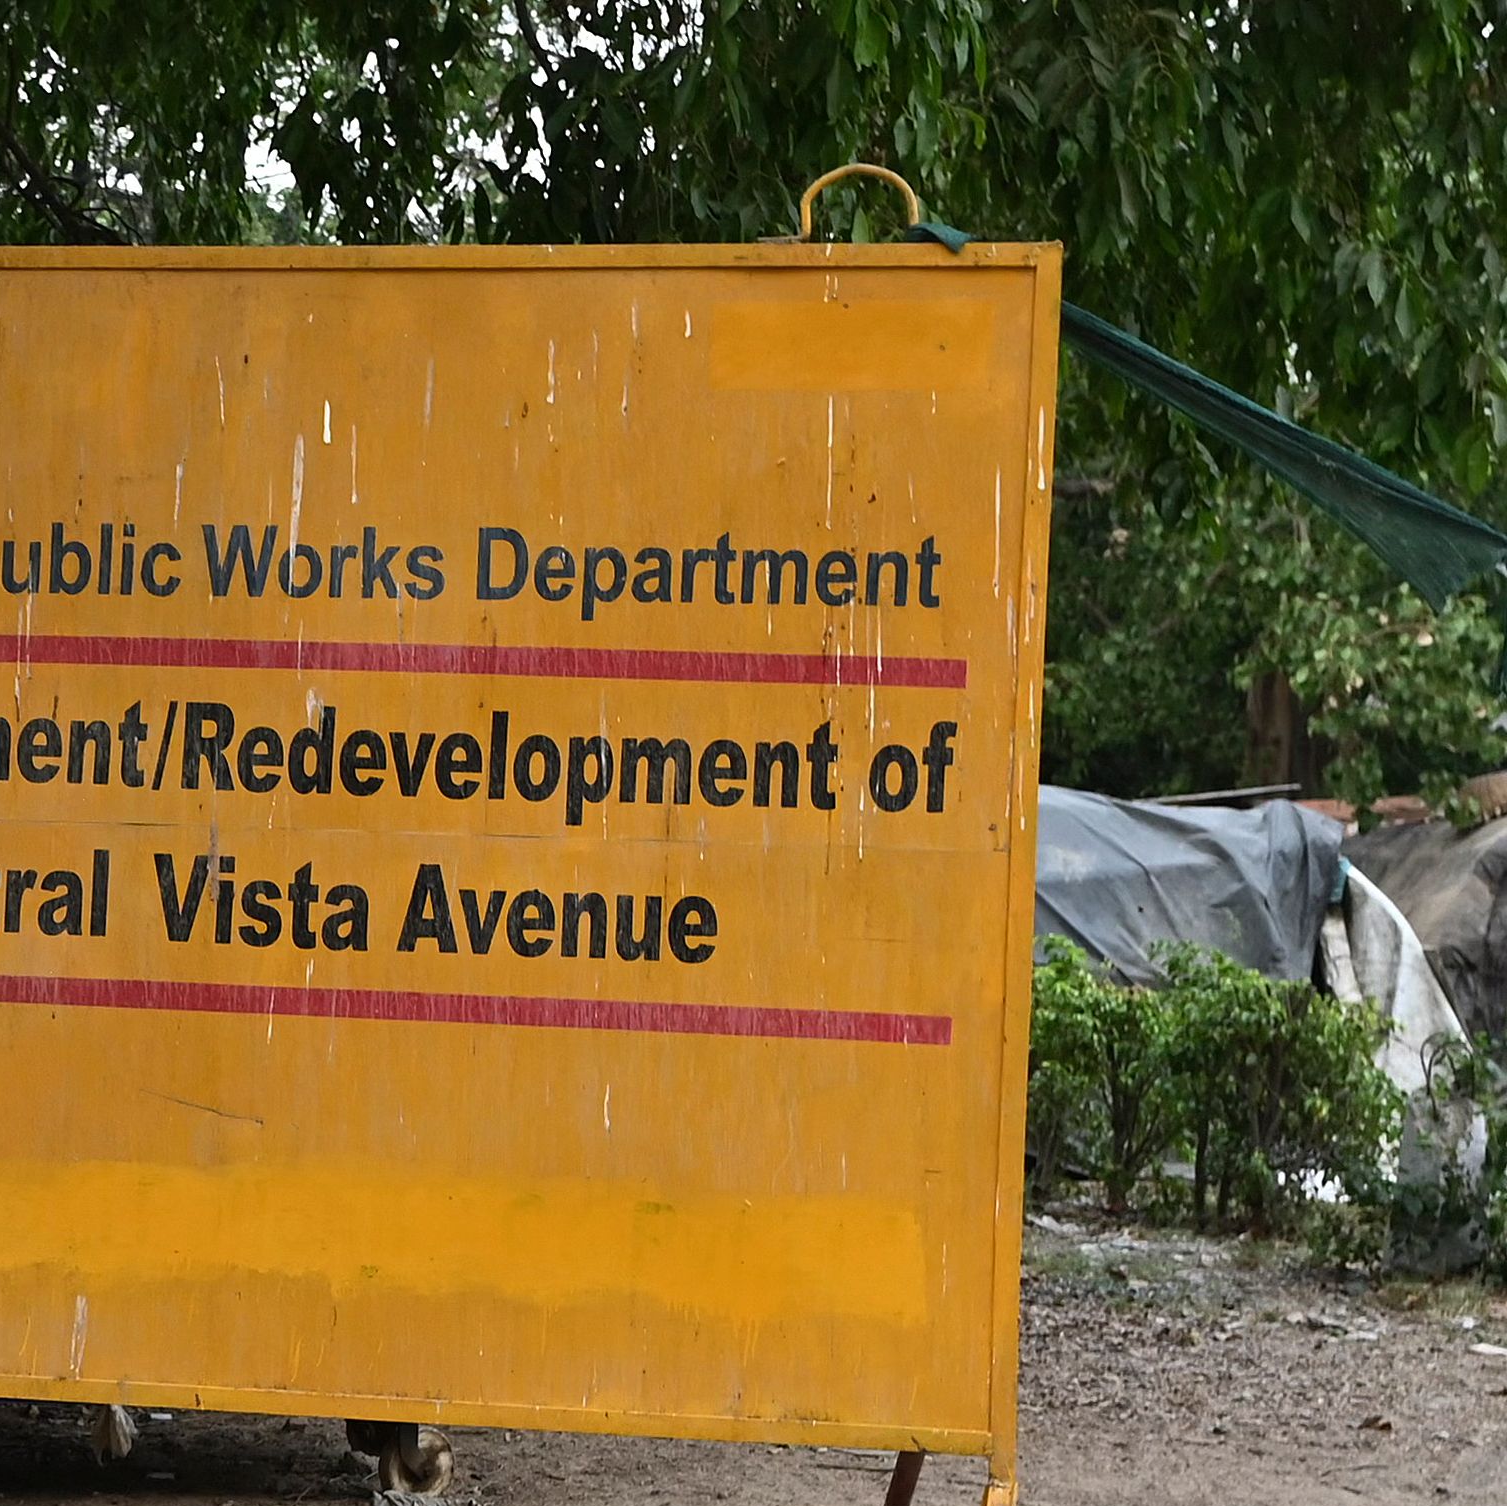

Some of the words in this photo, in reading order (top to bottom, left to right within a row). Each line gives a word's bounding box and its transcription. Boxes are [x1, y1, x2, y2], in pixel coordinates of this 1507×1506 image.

[201, 524, 445, 600] Works
[476, 527, 942, 622] Department
[868, 721, 959, 814] of
[153, 853, 369, 952] Vista
[396, 863, 718, 964] Avenue
